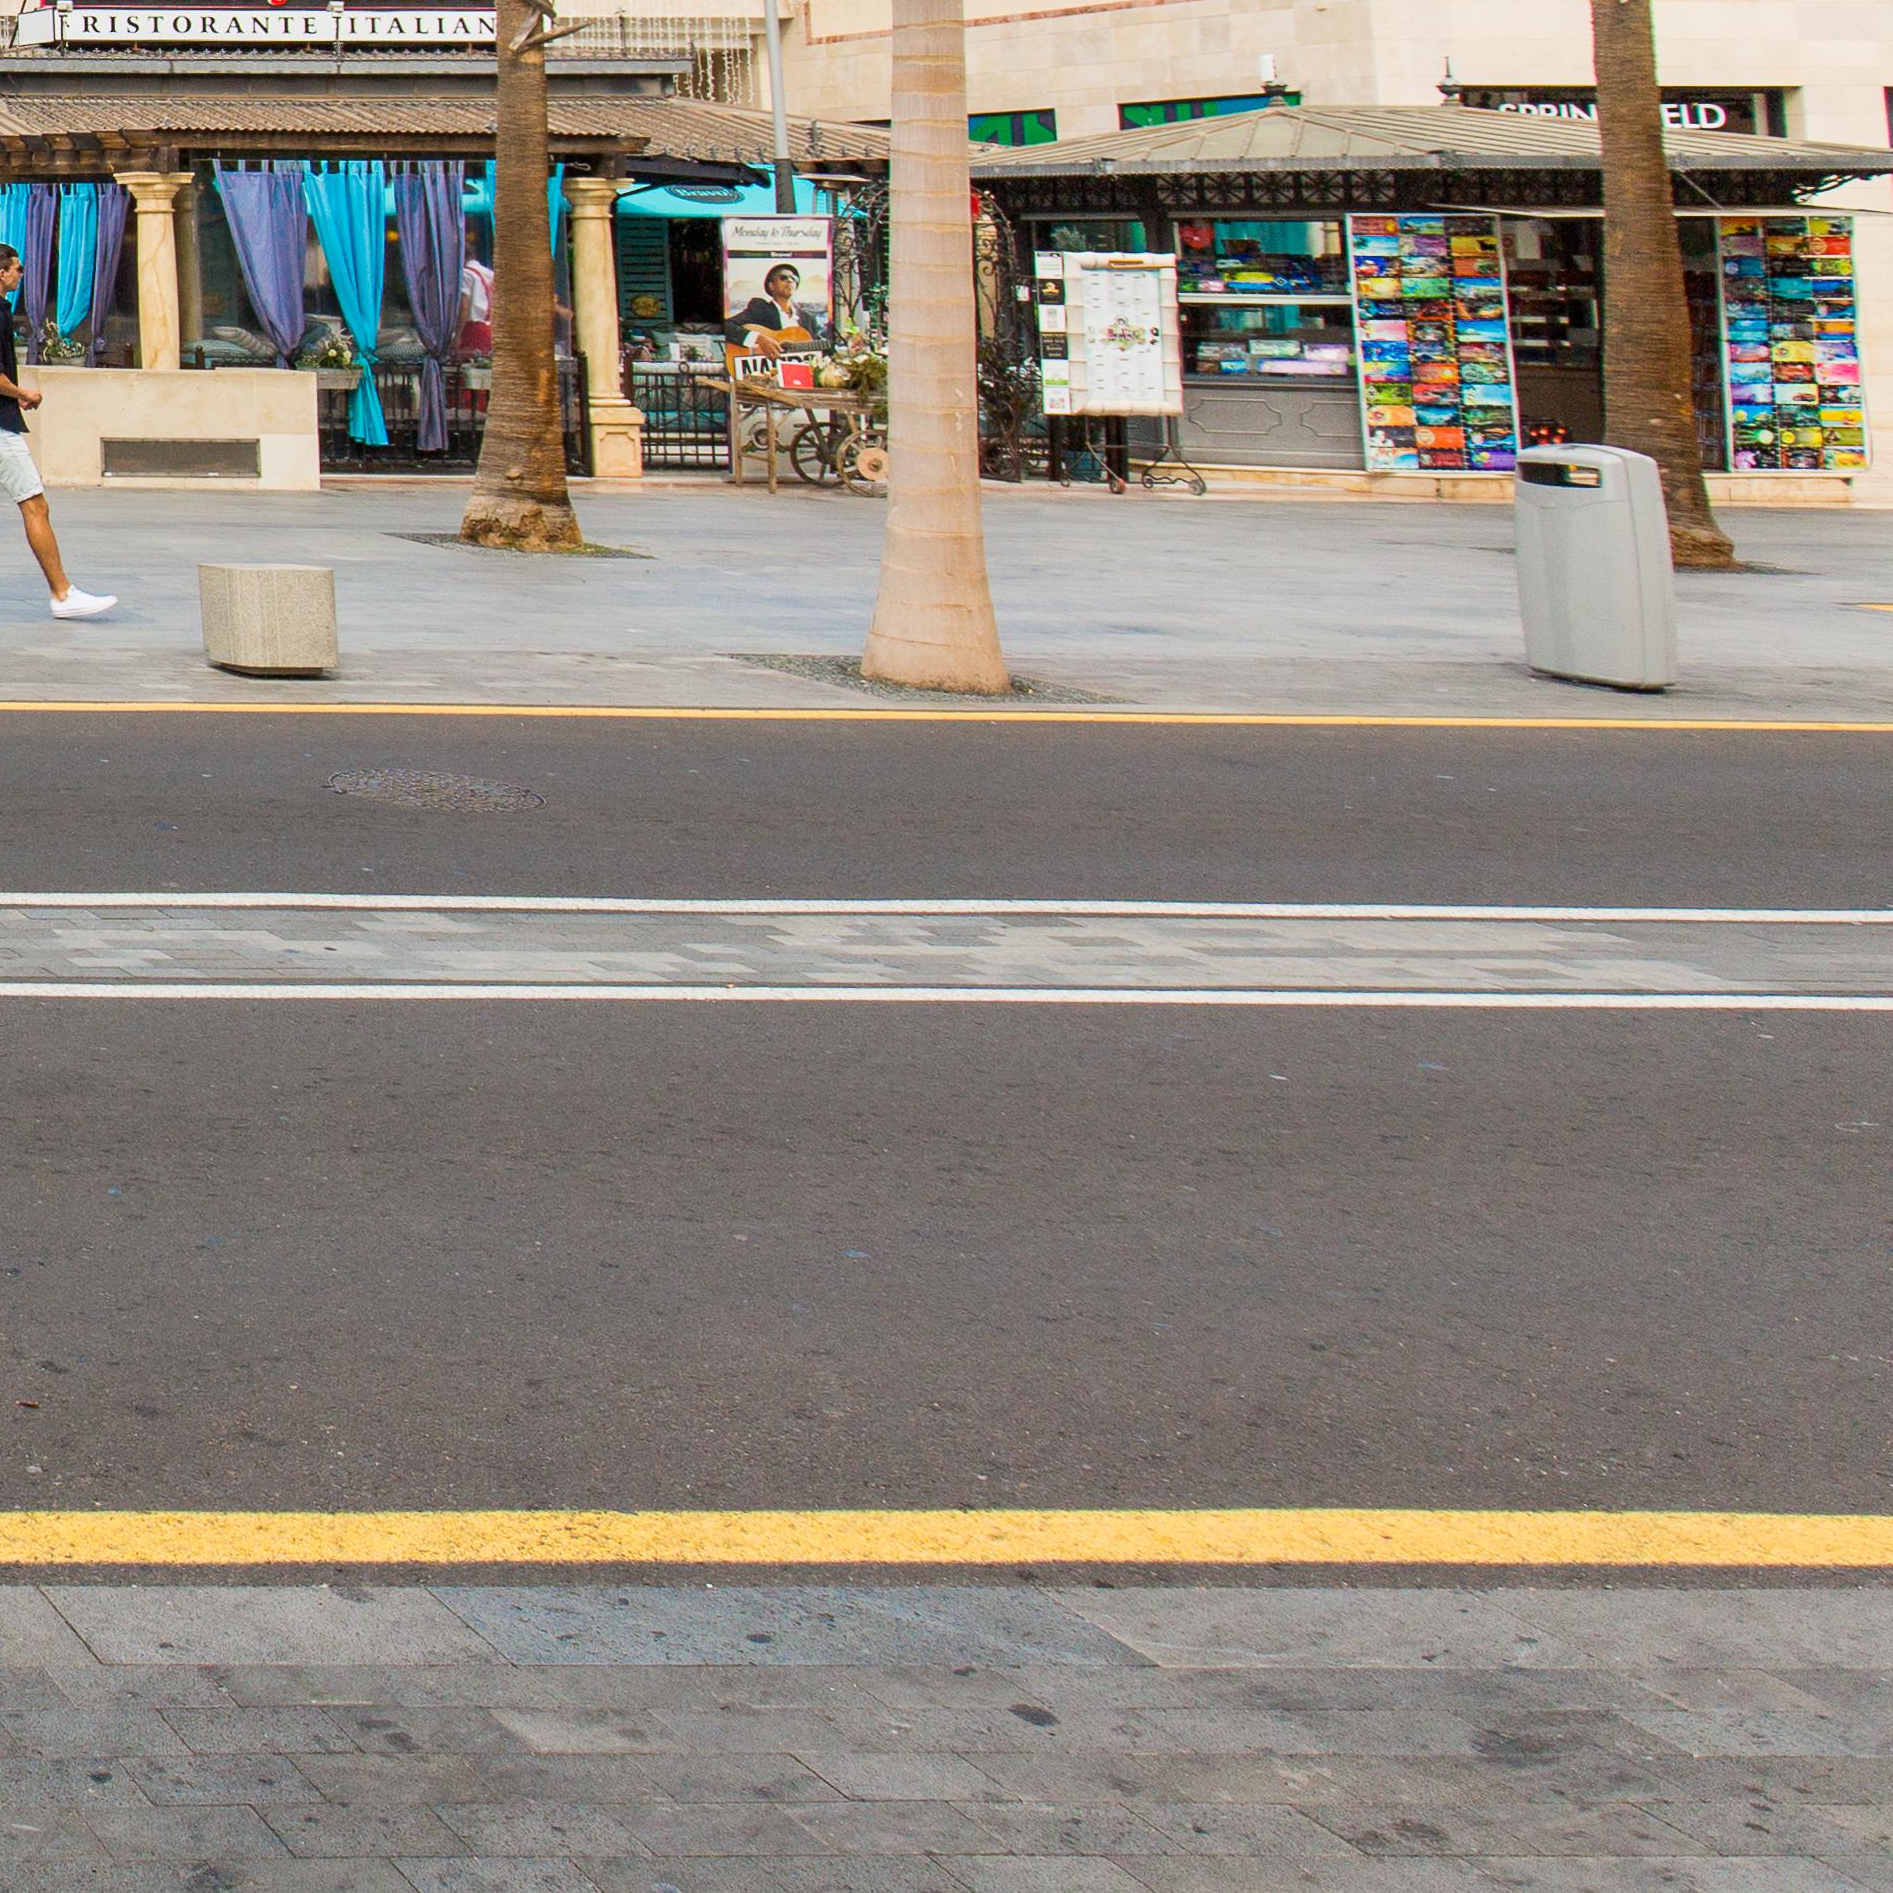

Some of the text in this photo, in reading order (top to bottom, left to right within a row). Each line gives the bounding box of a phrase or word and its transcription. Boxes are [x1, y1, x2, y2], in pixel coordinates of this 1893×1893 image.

[82, 16, 318, 35] RISTORANTE
[732, 225, 769, 240] Monday
[781, 225, 823, 241] Thursday
